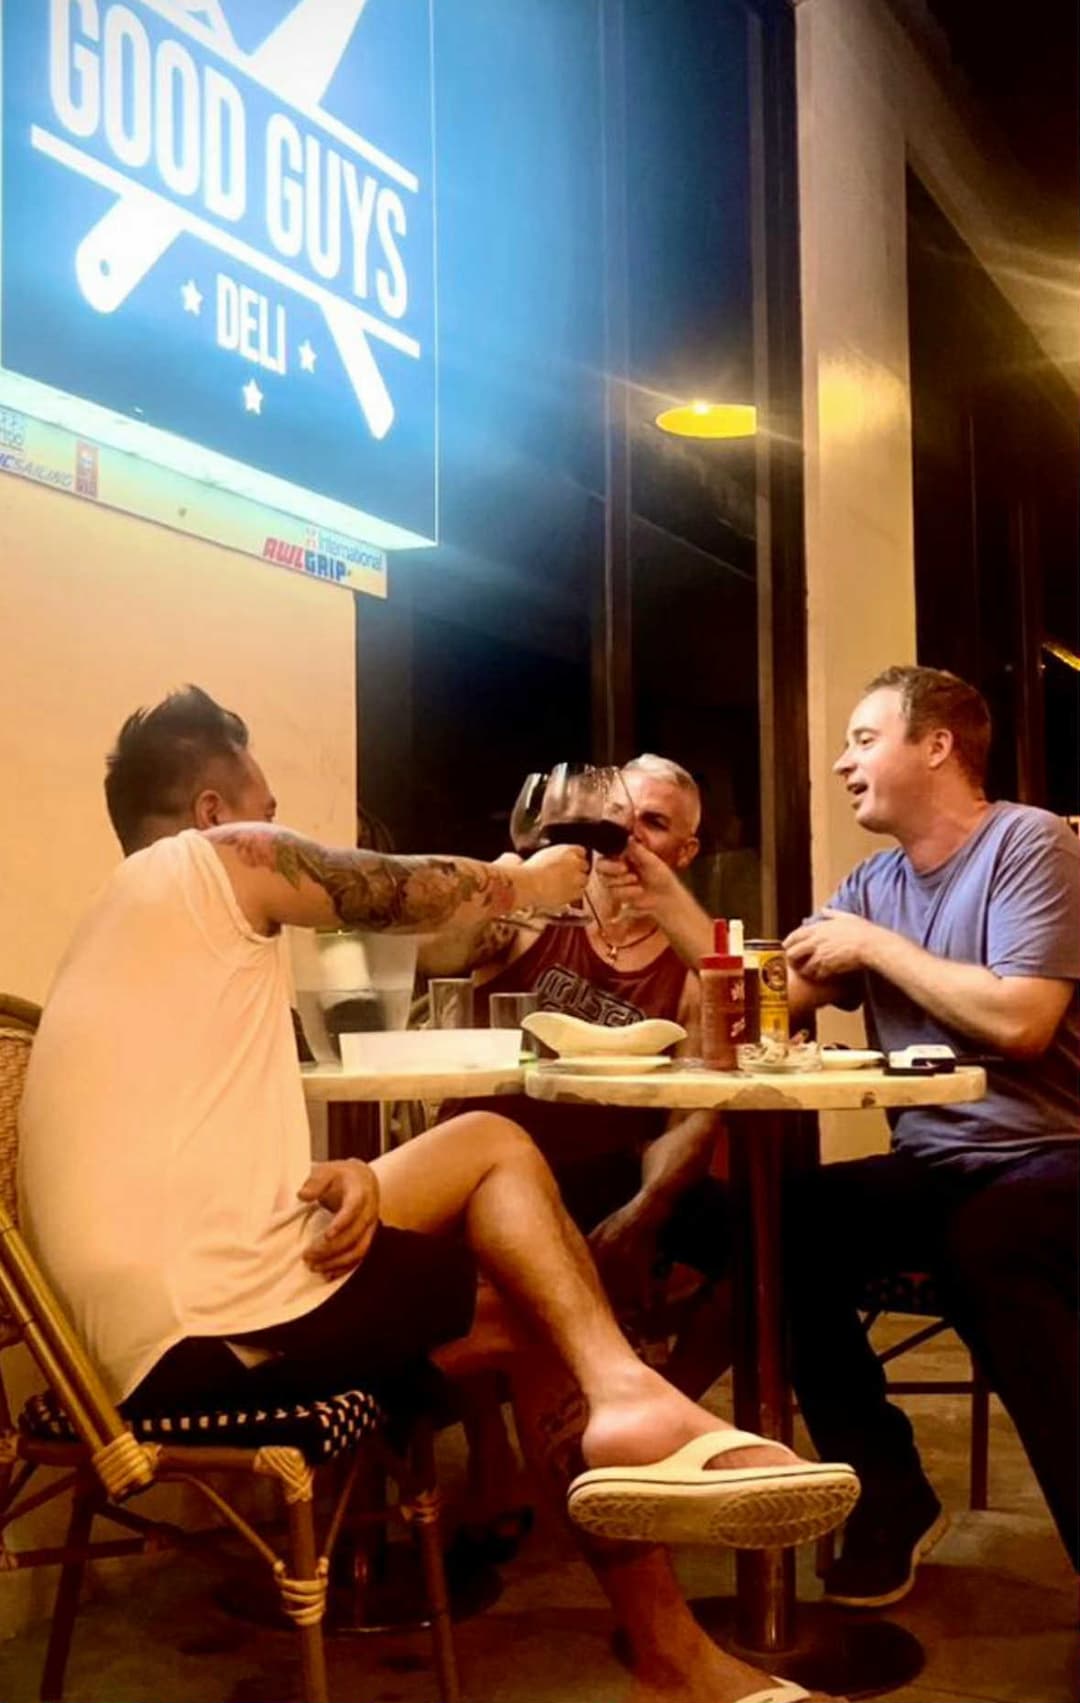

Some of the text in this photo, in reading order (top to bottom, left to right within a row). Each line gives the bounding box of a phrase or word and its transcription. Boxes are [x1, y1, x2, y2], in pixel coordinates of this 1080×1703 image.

[50, 0, 406, 319] GOOD GUYS
[216, 273, 287, 375] DELI
[263, 537, 346, 581] AWLGRIP
